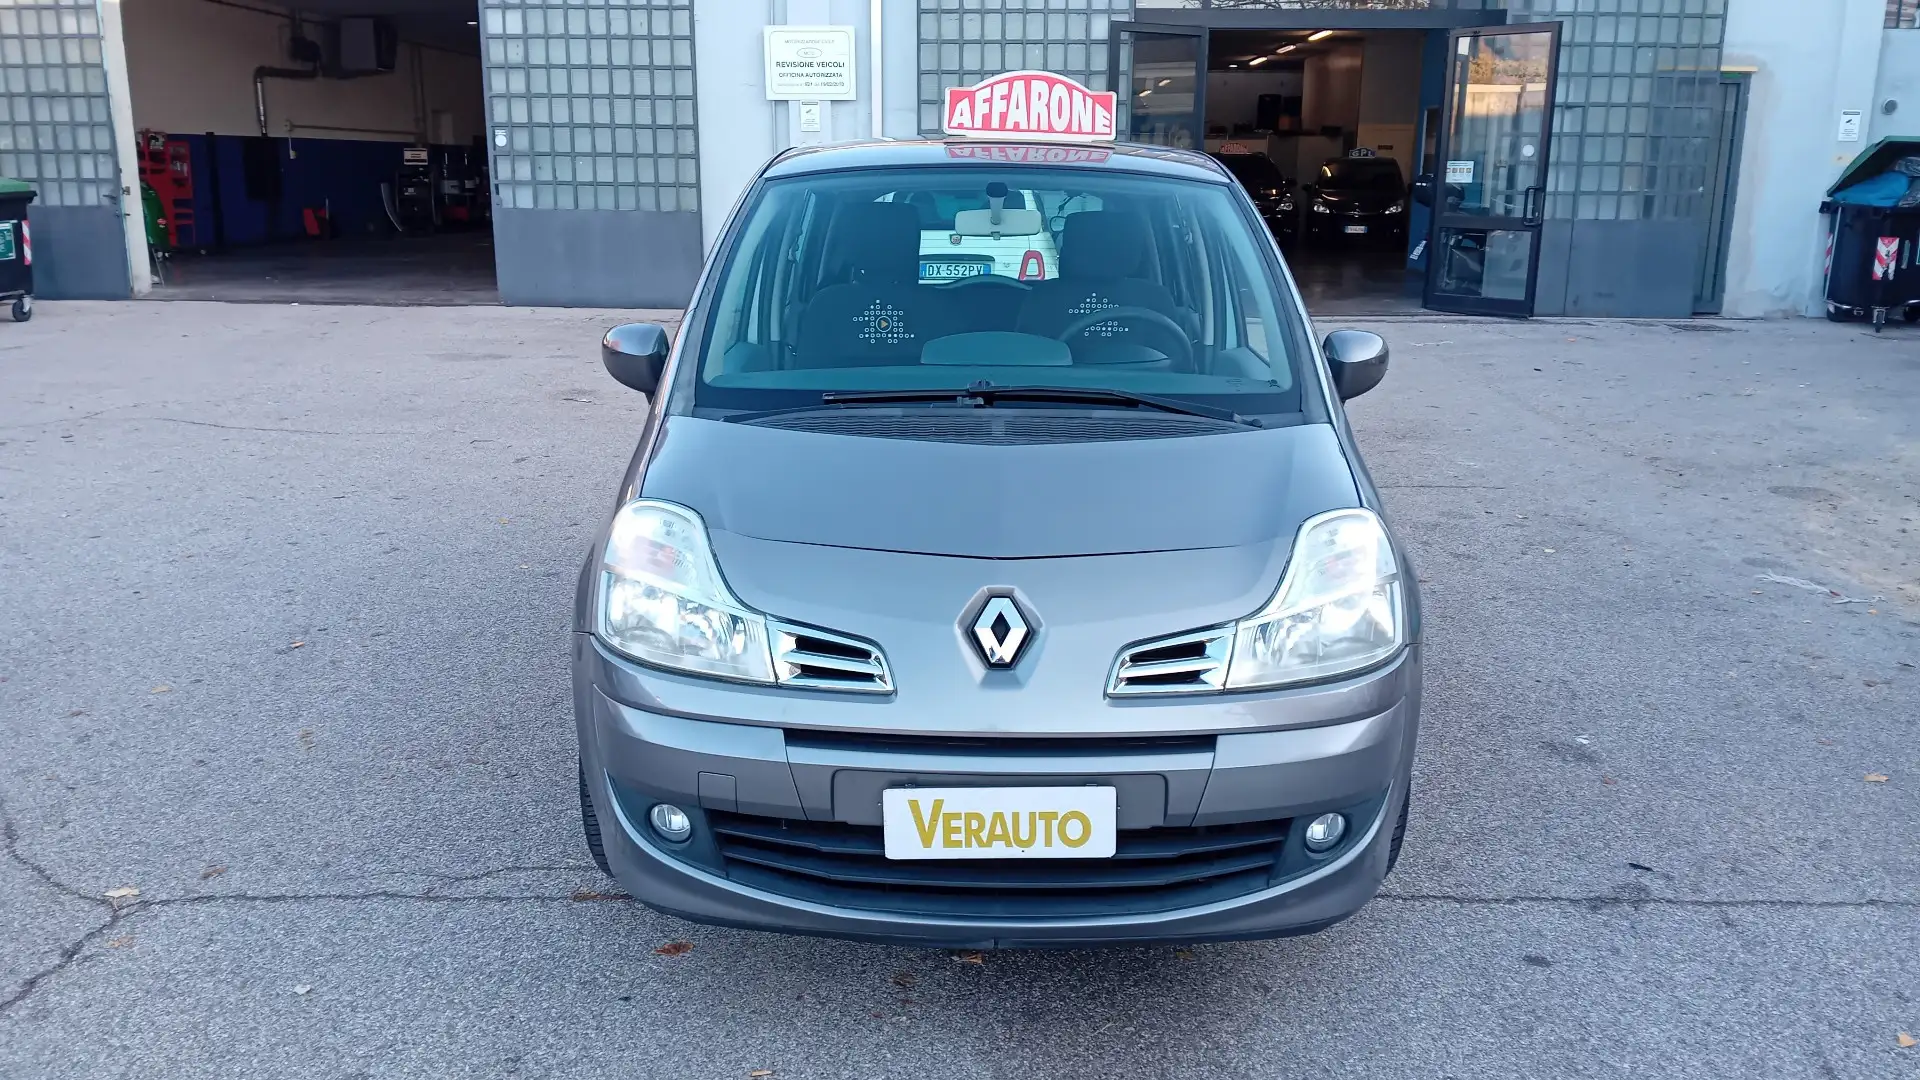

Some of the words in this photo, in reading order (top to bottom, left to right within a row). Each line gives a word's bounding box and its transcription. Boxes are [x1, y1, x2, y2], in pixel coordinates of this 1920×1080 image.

[949, 79, 1111, 133] AFFARONE
[927, 265, 941, 276] DX
[943, 265, 983, 276] 552PV
[908, 798, 1092, 849] VERAUTO
